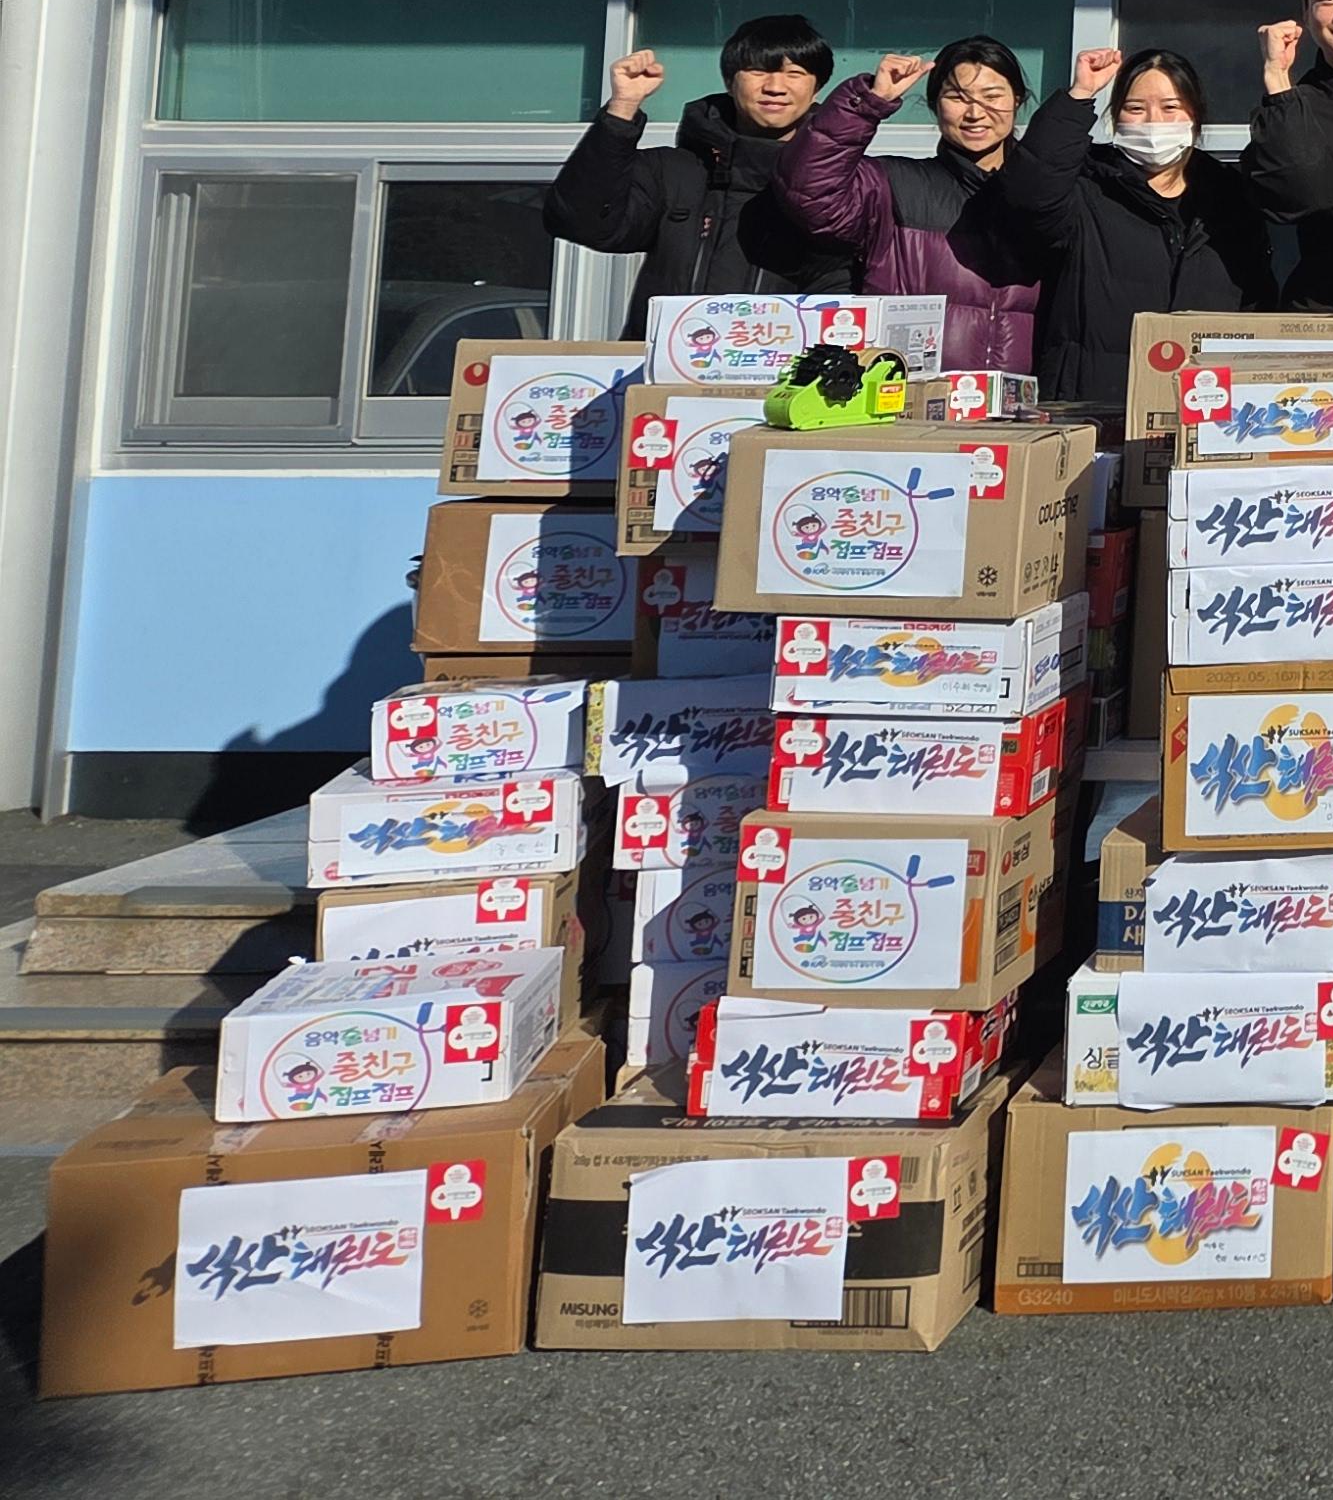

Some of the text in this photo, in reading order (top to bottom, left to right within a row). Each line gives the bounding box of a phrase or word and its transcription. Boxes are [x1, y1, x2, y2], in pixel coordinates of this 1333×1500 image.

[724, 321, 795, 347] 줄친구
[723, 349, 793, 368] 점프점프
[831, 509, 906, 538] 줄친구
[830, 540, 904, 561] 점프점프
[437, 700, 505, 718] 악줄넘기
[446, 720, 523, 751] 줄친구
[447, 749, 526, 770] 점프점프
[829, 898, 905, 928] 줄친구
[828, 931, 903, 954] 점프점프
[329, 1050, 417, 1083] 줄친구
[328, 1082, 416, 1106] 점프점프
[559, 1302, 619, 1316] MISUNG
